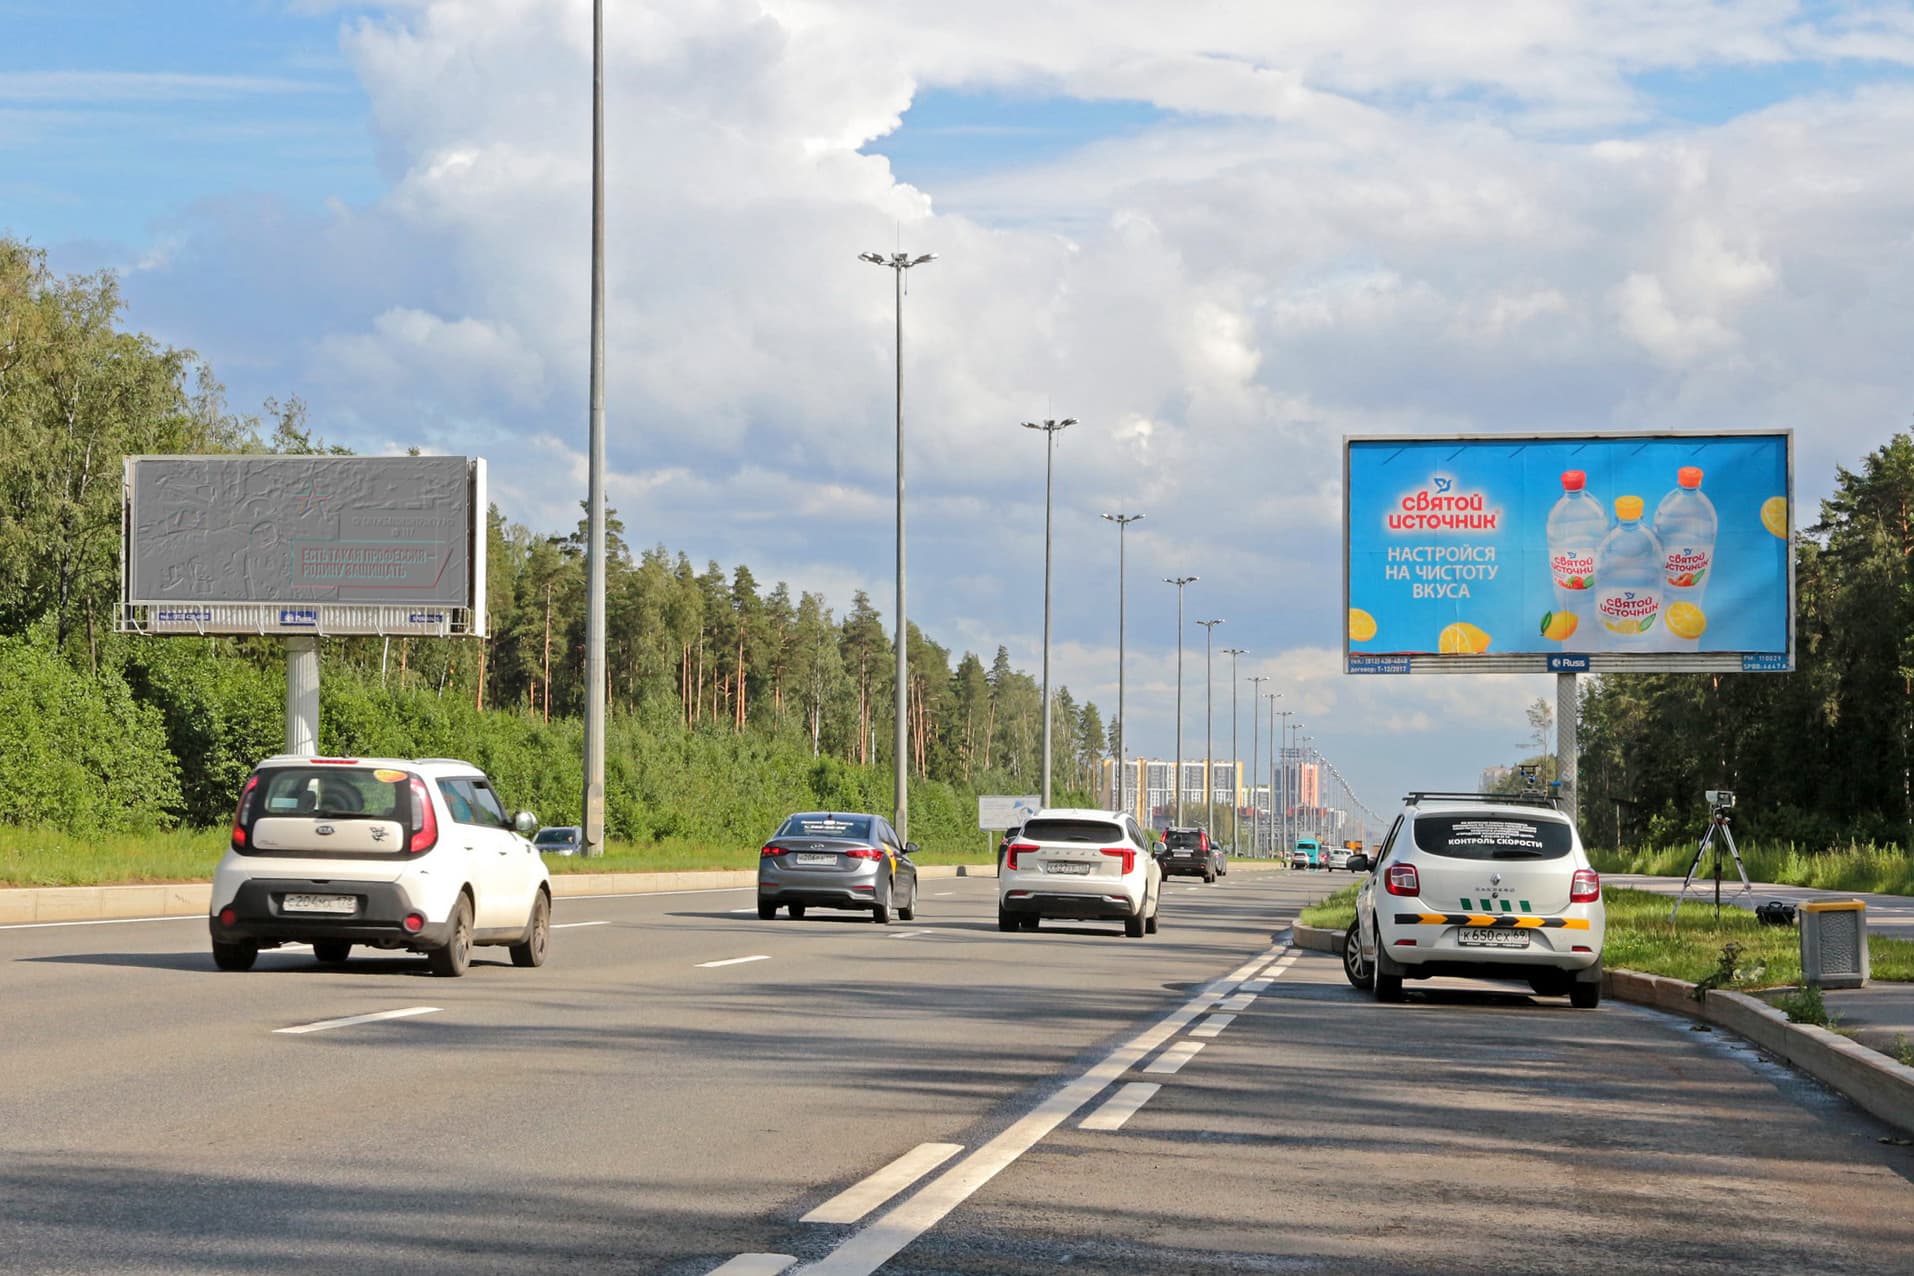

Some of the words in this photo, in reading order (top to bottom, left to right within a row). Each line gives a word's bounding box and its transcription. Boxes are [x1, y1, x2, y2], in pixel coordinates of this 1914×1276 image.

[1387, 543, 1496, 562] НАСТРОЙСЯ
[1385, 565, 1411, 580] НА
[1415, 565, 1499, 580] ЧИСТОТУ
[1412, 583, 1471, 598] ВКУСА
[1563, 658, 1585, 667] Russ
[1448, 838, 1495, 847] КОНТРОЛЬ
[1496, 838, 1543, 849] СКОРОСТИ
